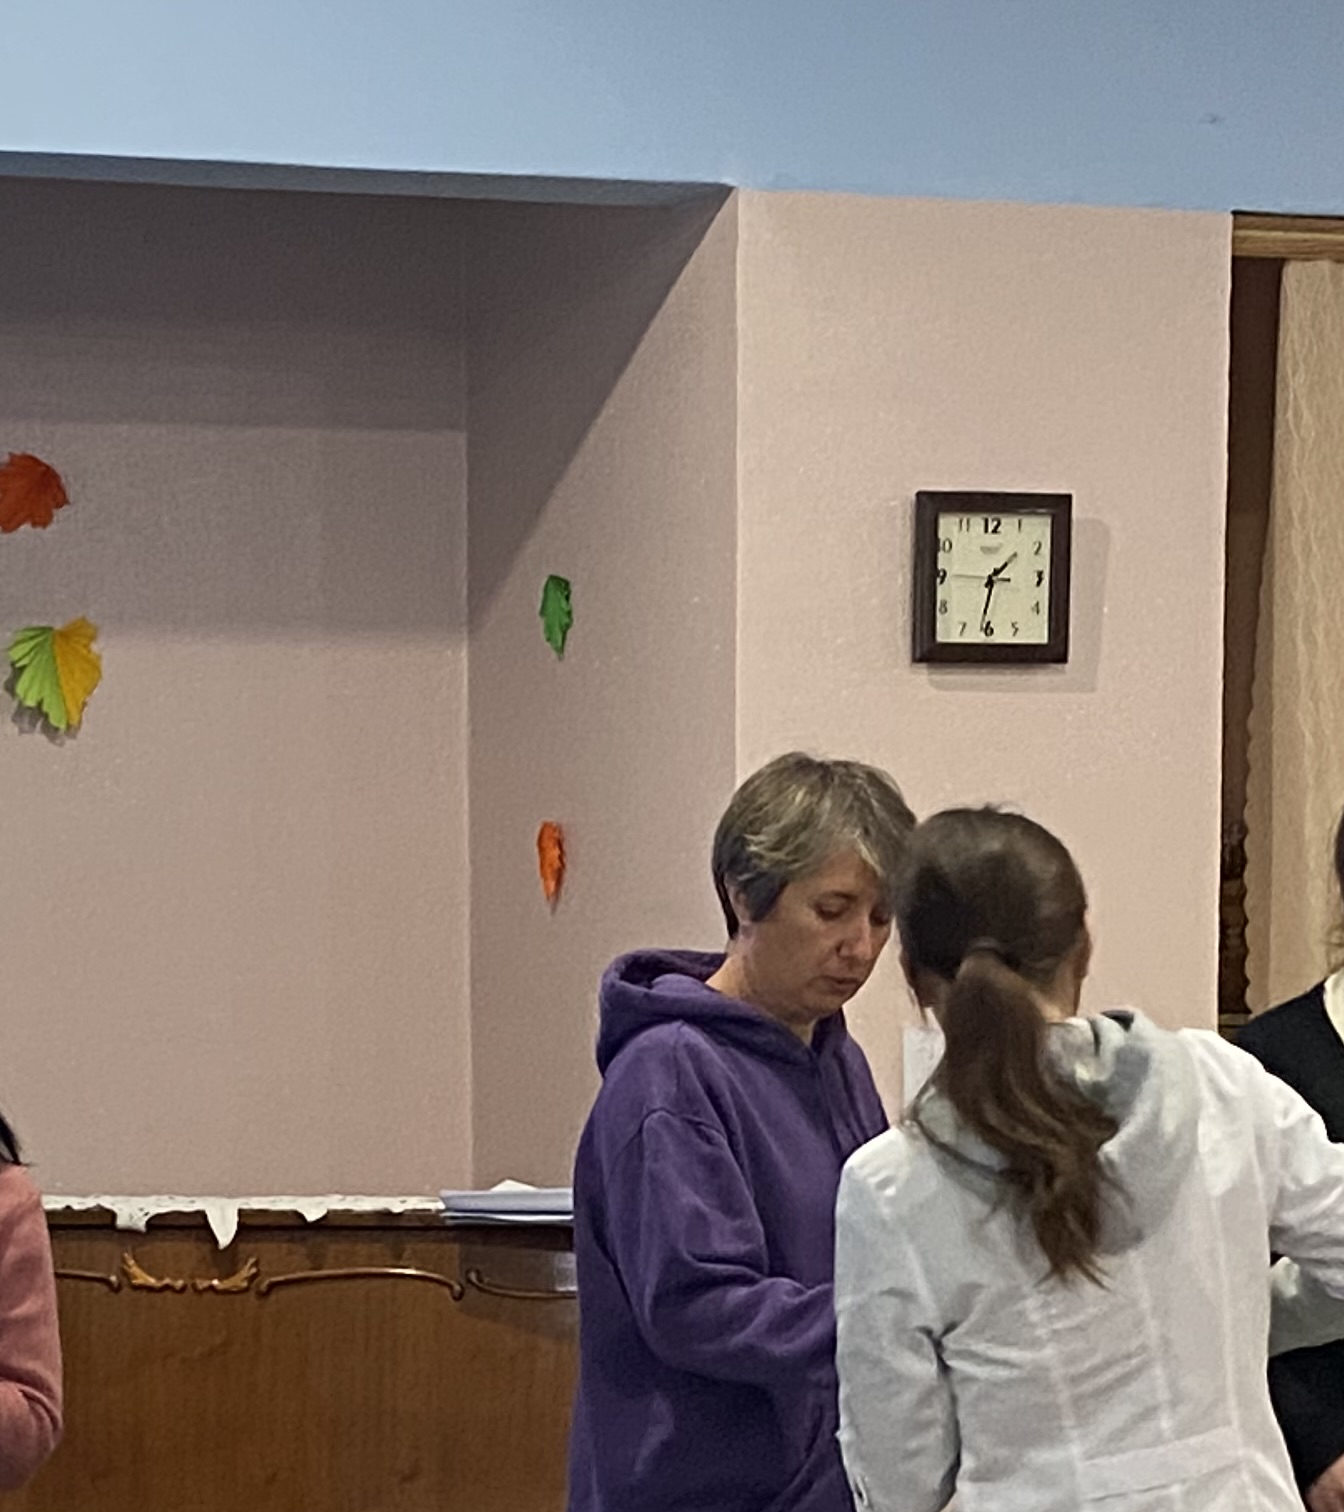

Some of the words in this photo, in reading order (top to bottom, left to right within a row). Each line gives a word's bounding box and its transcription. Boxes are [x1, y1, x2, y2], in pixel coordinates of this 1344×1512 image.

[958, 518, 970, 533] 11
[983, 517, 1001, 534] 12
[1017, 518, 1022, 533] 1
[1032, 540, 1043, 556] 2
[936, 568, 948, 585] 9
[1034, 570, 1044, 588] 3
[938, 599, 949, 615] 8
[1031, 601, 1041, 616] 4
[958, 621, 968, 637] 7
[984, 620, 995, 637] 6
[1011, 621, 1020, 637] 5
